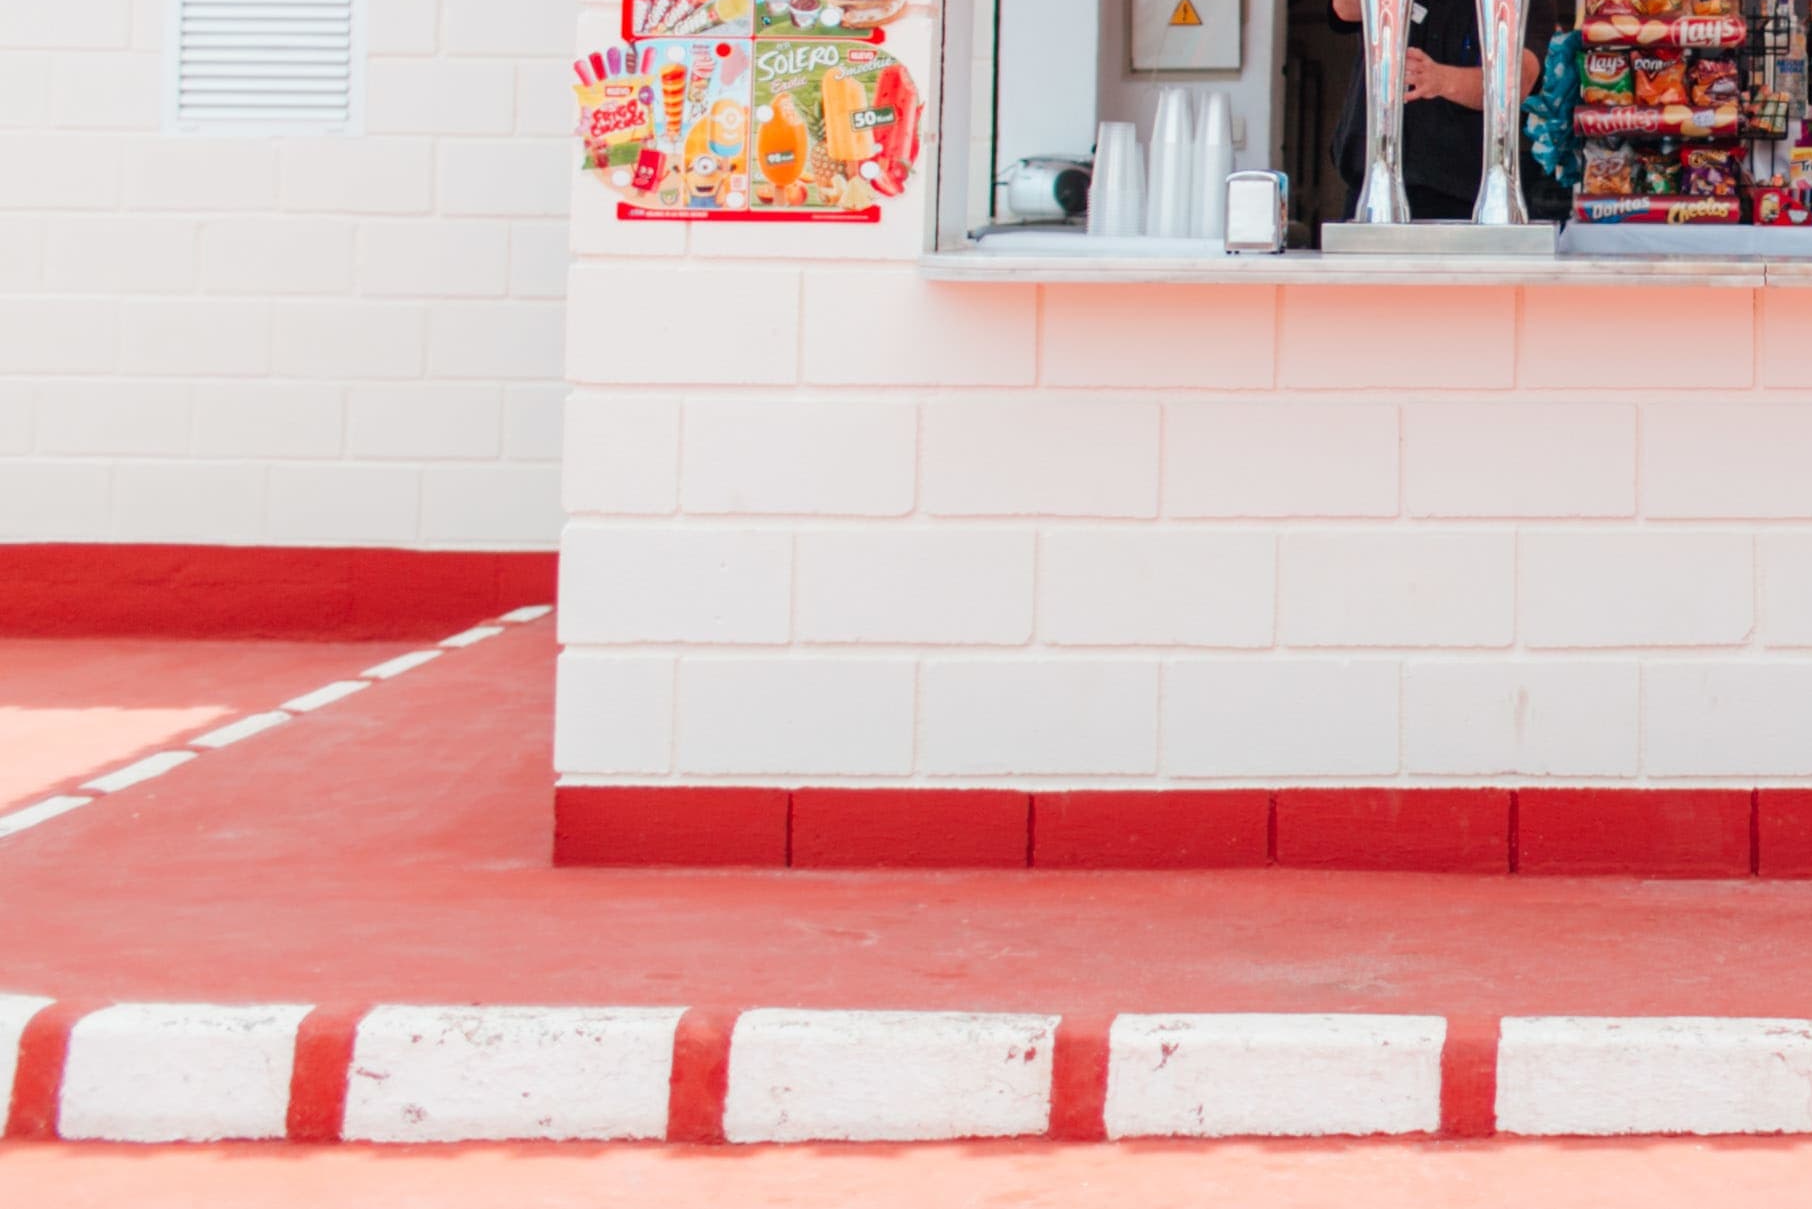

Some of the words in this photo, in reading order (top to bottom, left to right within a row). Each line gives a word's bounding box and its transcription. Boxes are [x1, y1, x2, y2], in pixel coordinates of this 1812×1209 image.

[1680, 18, 1736, 46] Lay's
[758, 45, 839, 81] SOLERO
[1589, 55, 1625, 75] Lay's
[1582, 106, 1658, 133] Ruffles
[1592, 197, 1650, 220] Doritos
[1667, 198, 1731, 224] Cheetos
